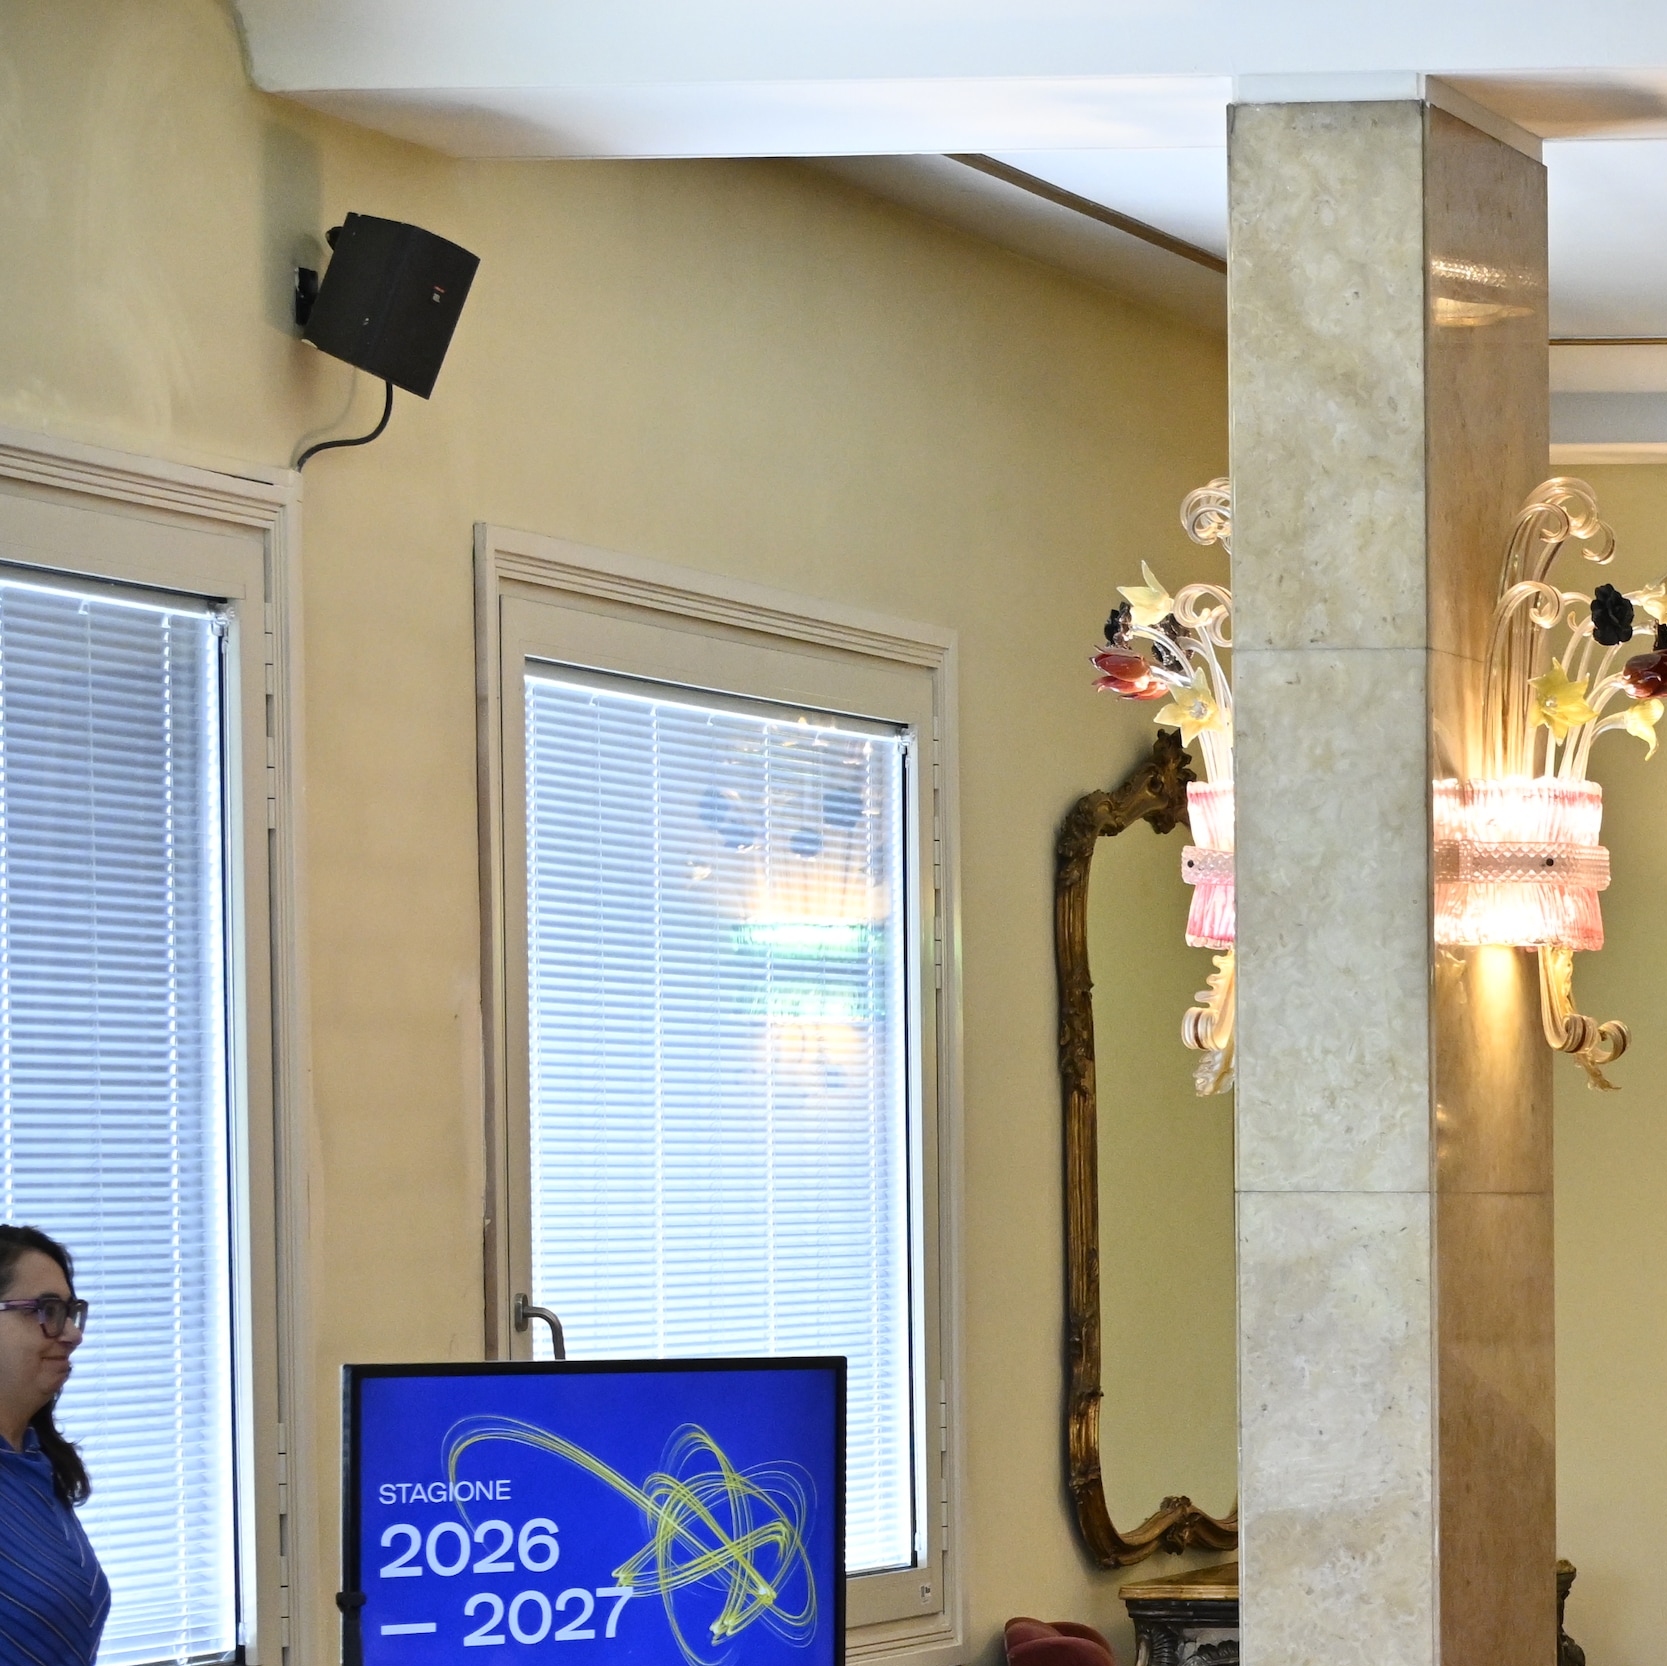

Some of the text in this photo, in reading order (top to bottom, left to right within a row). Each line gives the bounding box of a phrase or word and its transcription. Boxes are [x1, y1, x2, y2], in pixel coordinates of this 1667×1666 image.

[379, 1480, 512, 1505] STAGIONE
[380, 1517, 560, 1579] 2026
[463, 1586, 634, 1647] 2027
